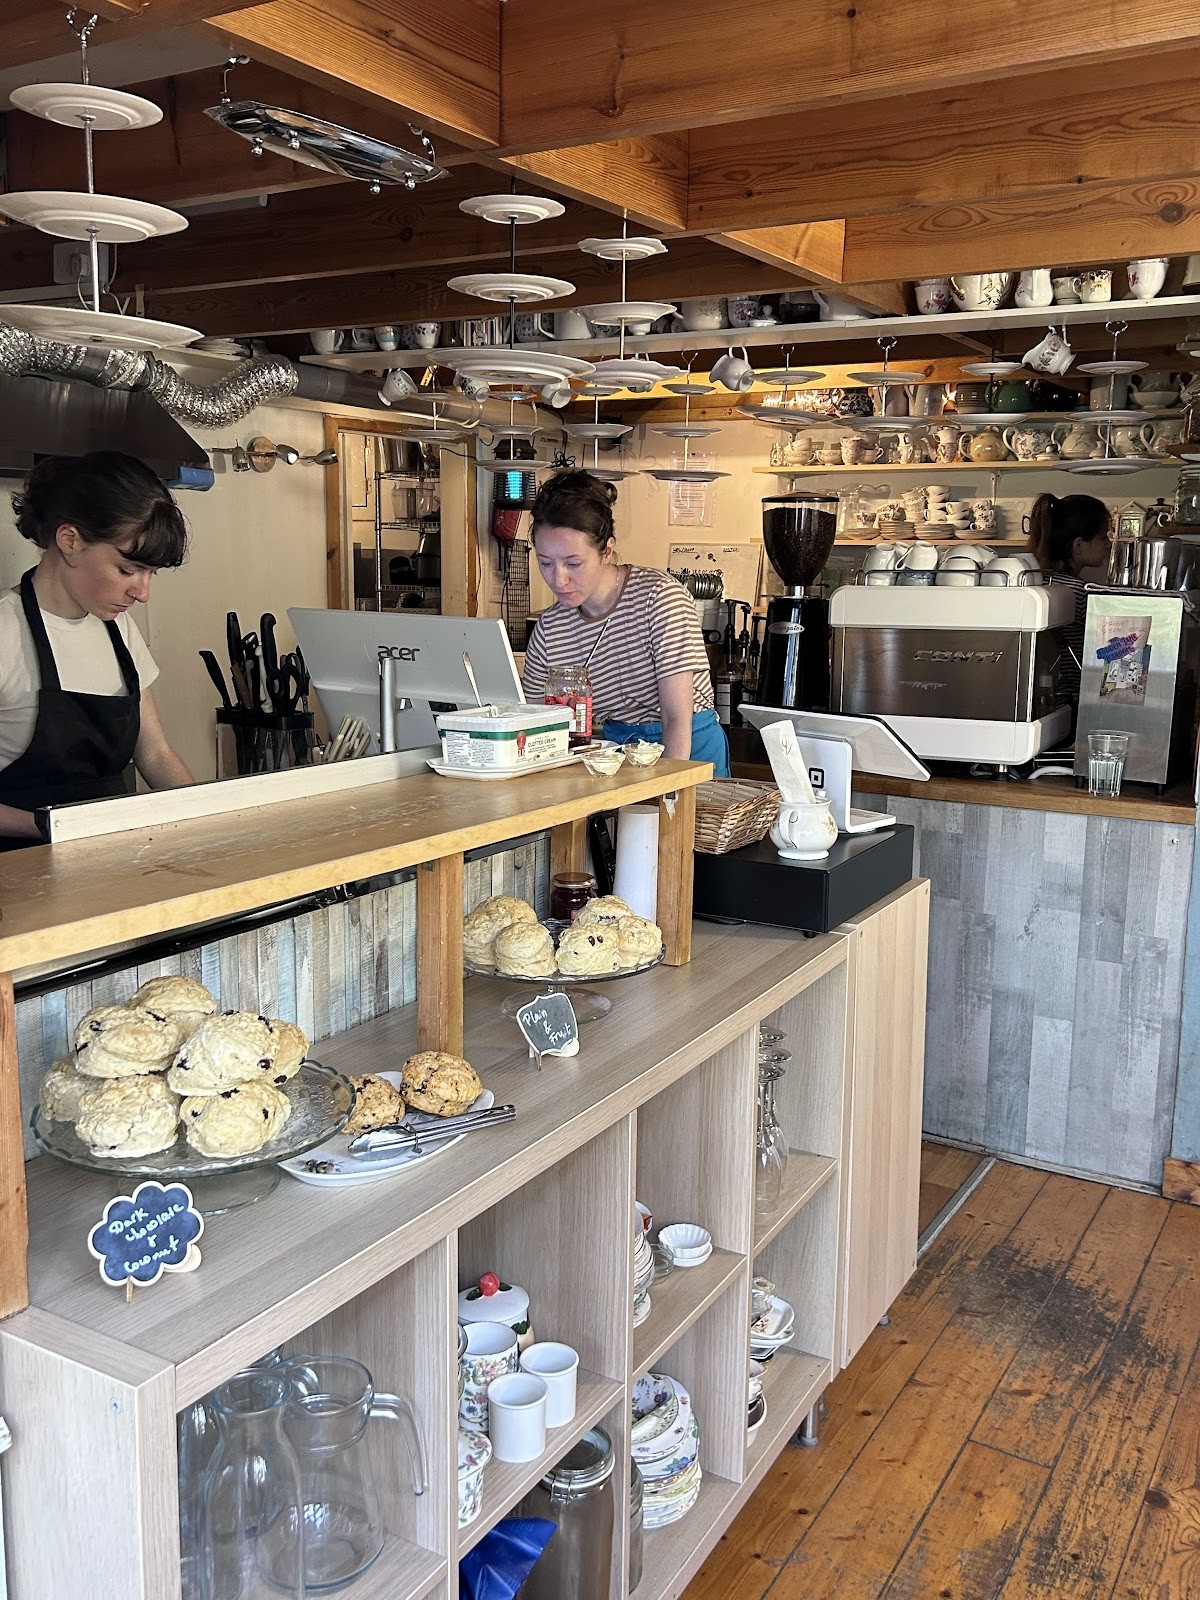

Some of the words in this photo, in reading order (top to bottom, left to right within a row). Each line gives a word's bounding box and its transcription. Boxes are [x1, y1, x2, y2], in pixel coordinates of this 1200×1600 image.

[378, 646, 420, 661] acer
[522, 1009, 548, 1026] Plain
[549, 1022, 571, 1045] Fruit
[108, 1207, 149, 1234] Dark
